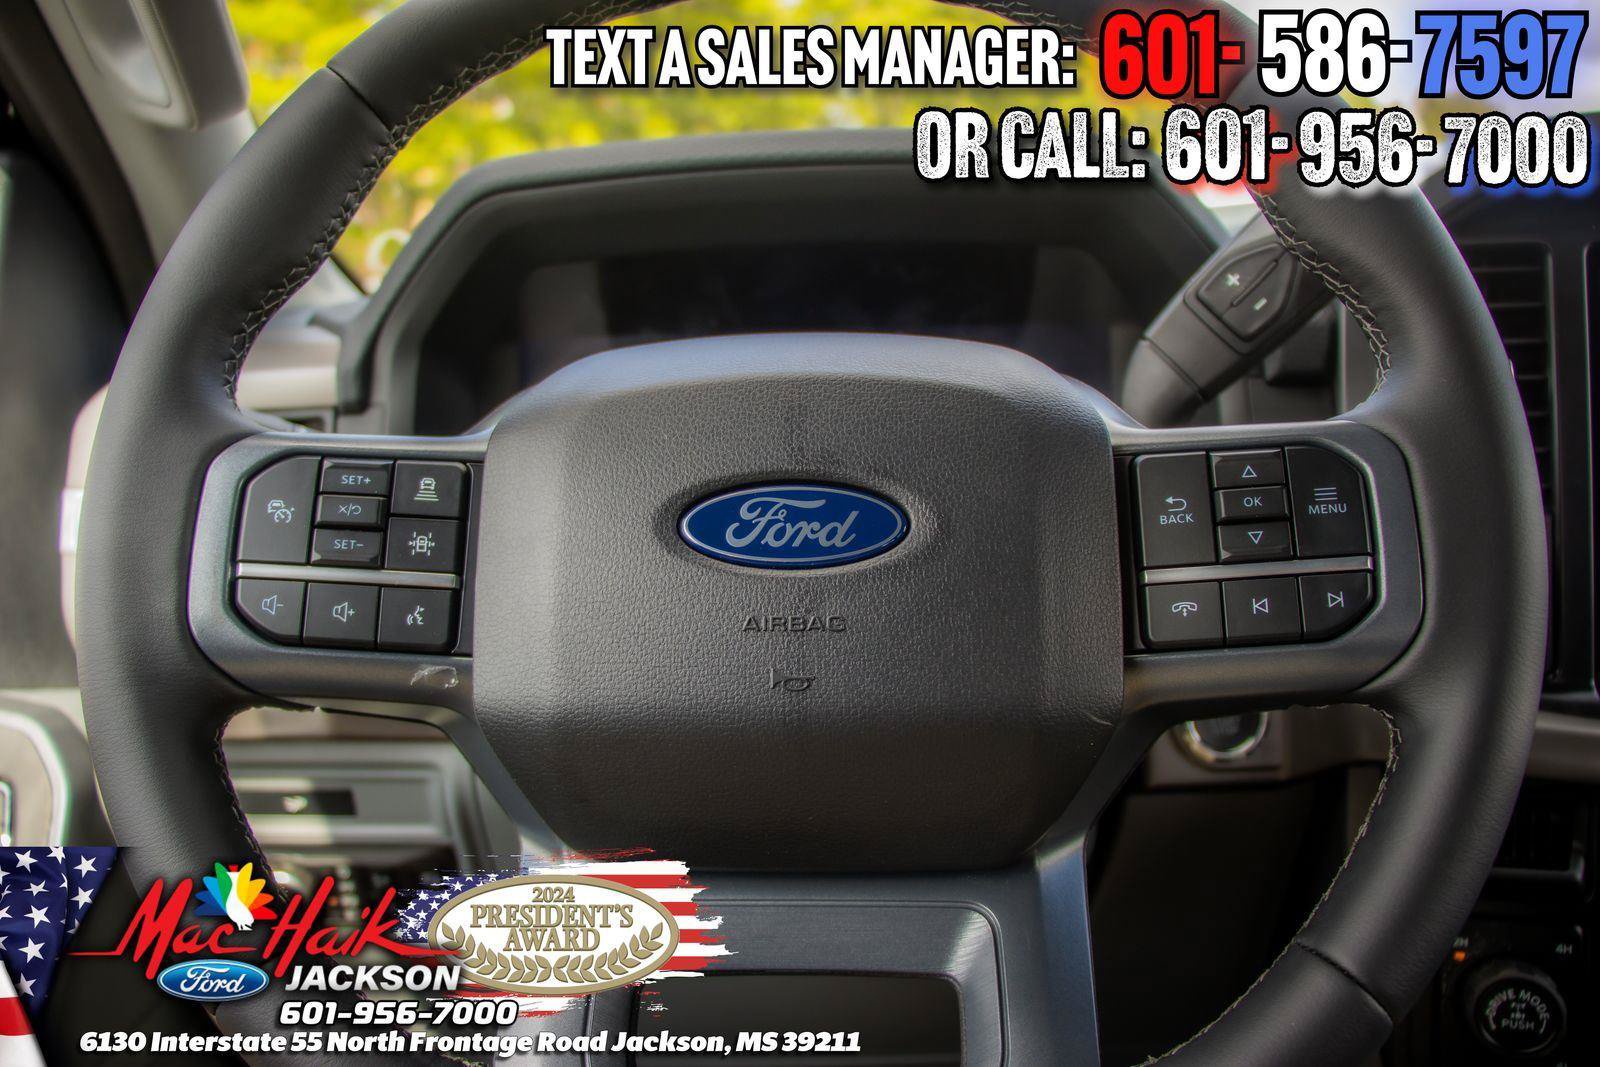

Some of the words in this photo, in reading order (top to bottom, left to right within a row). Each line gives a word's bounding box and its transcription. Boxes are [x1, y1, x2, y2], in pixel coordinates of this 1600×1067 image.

[341, 474, 372, 486] SET+
[1242, 496, 1263, 508] OK
[1307, 502, 1347, 516] MENU
[725, 497, 860, 548] Ford
[1159, 513, 1195, 525] BACK
[333, 538, 365, 550] SET-
[741, 615, 847, 633] AIRBAG
[1554, 943, 1573, 955] 4H
[1518, 988, 1550, 1021] MODE
[1501, 1017, 1535, 1031] PUSH
